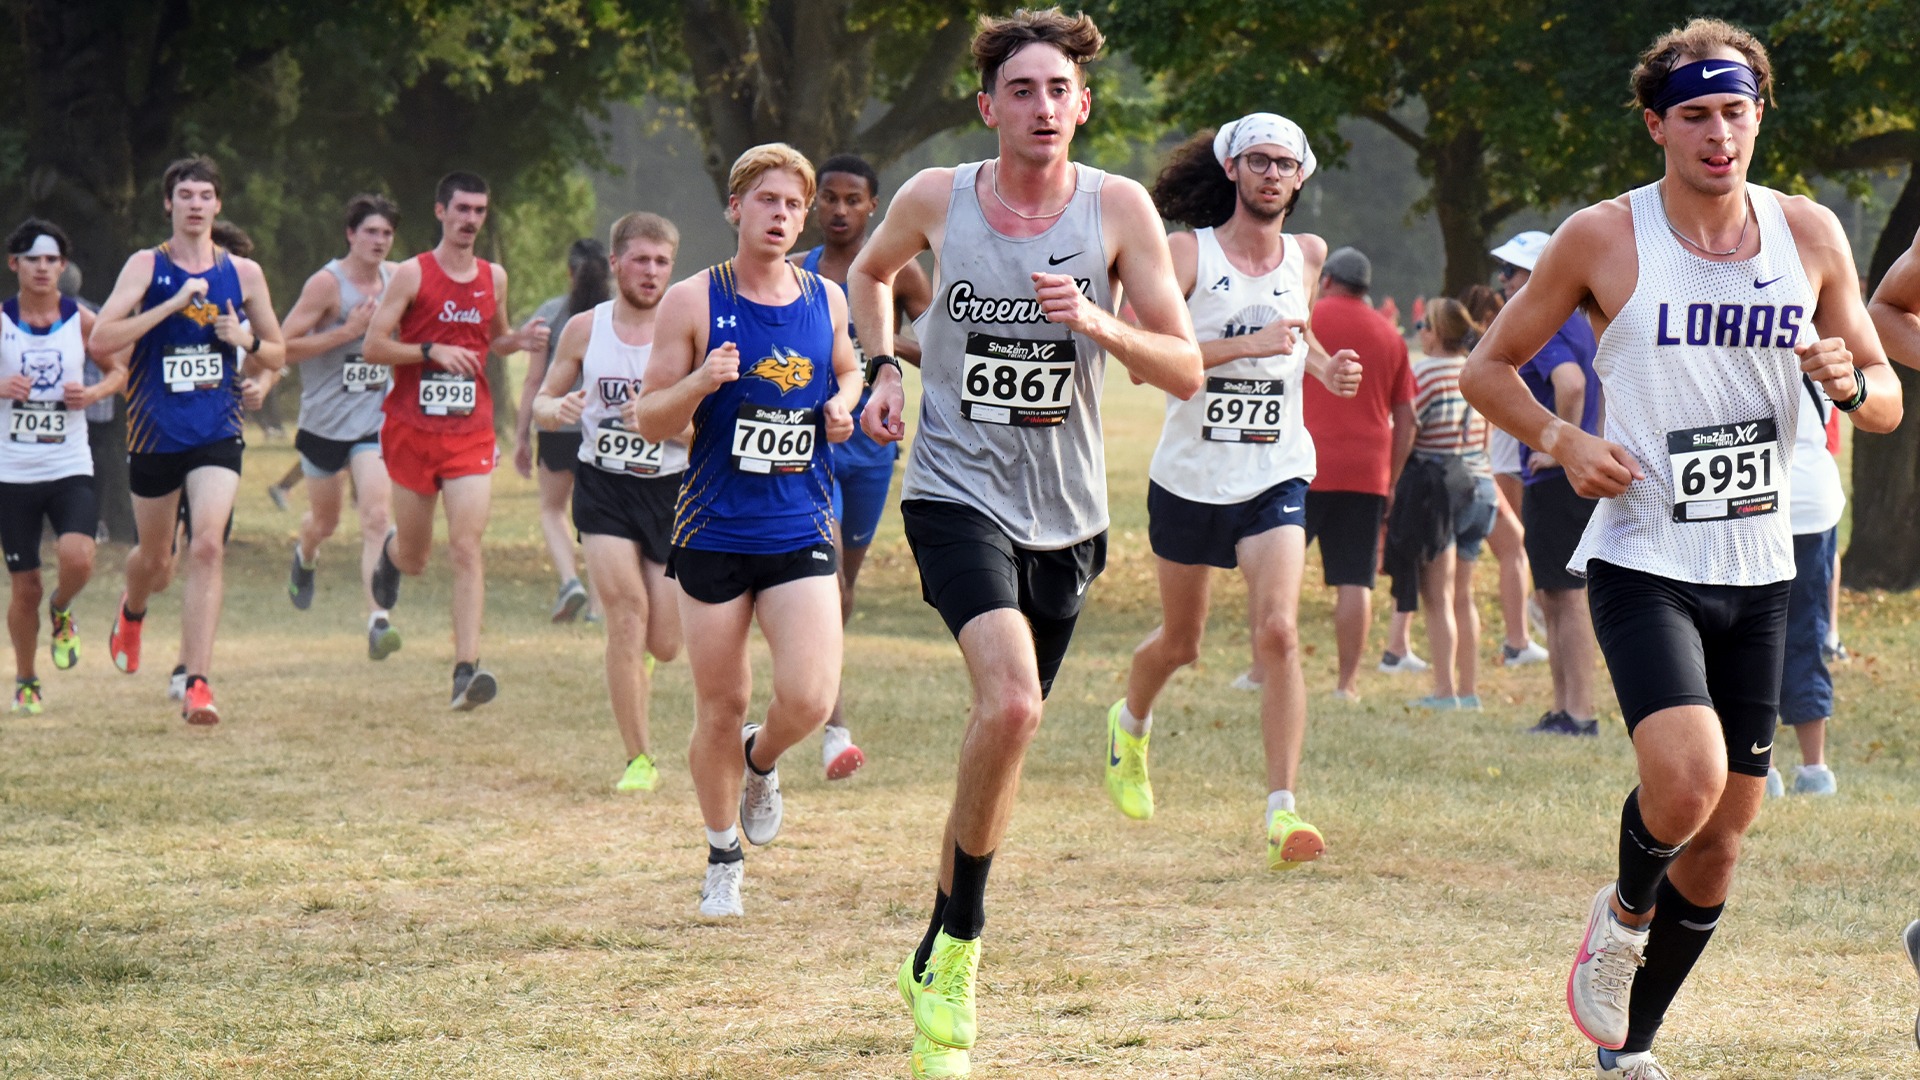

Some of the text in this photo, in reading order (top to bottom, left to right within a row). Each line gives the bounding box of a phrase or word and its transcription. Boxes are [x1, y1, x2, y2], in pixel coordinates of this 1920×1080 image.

[1657, 303, 1804, 348] LORAS
[988, 341, 1057, 360] ShaZam XC
[166, 358, 220, 378] 7055
[422, 385, 473, 403] 6998
[966, 362, 1072, 403] 6867
[1251, 381, 1272, 395] XC
[13, 413, 65, 432] 7043
[785, 409, 805, 425] XC
[1206, 397, 1280, 425] 6978
[738, 424, 812, 456] 7060
[1692, 422, 1759, 446] ShaZam XC
[597, 434, 661, 461] 6992
[1681, 448, 1771, 496] 6951
